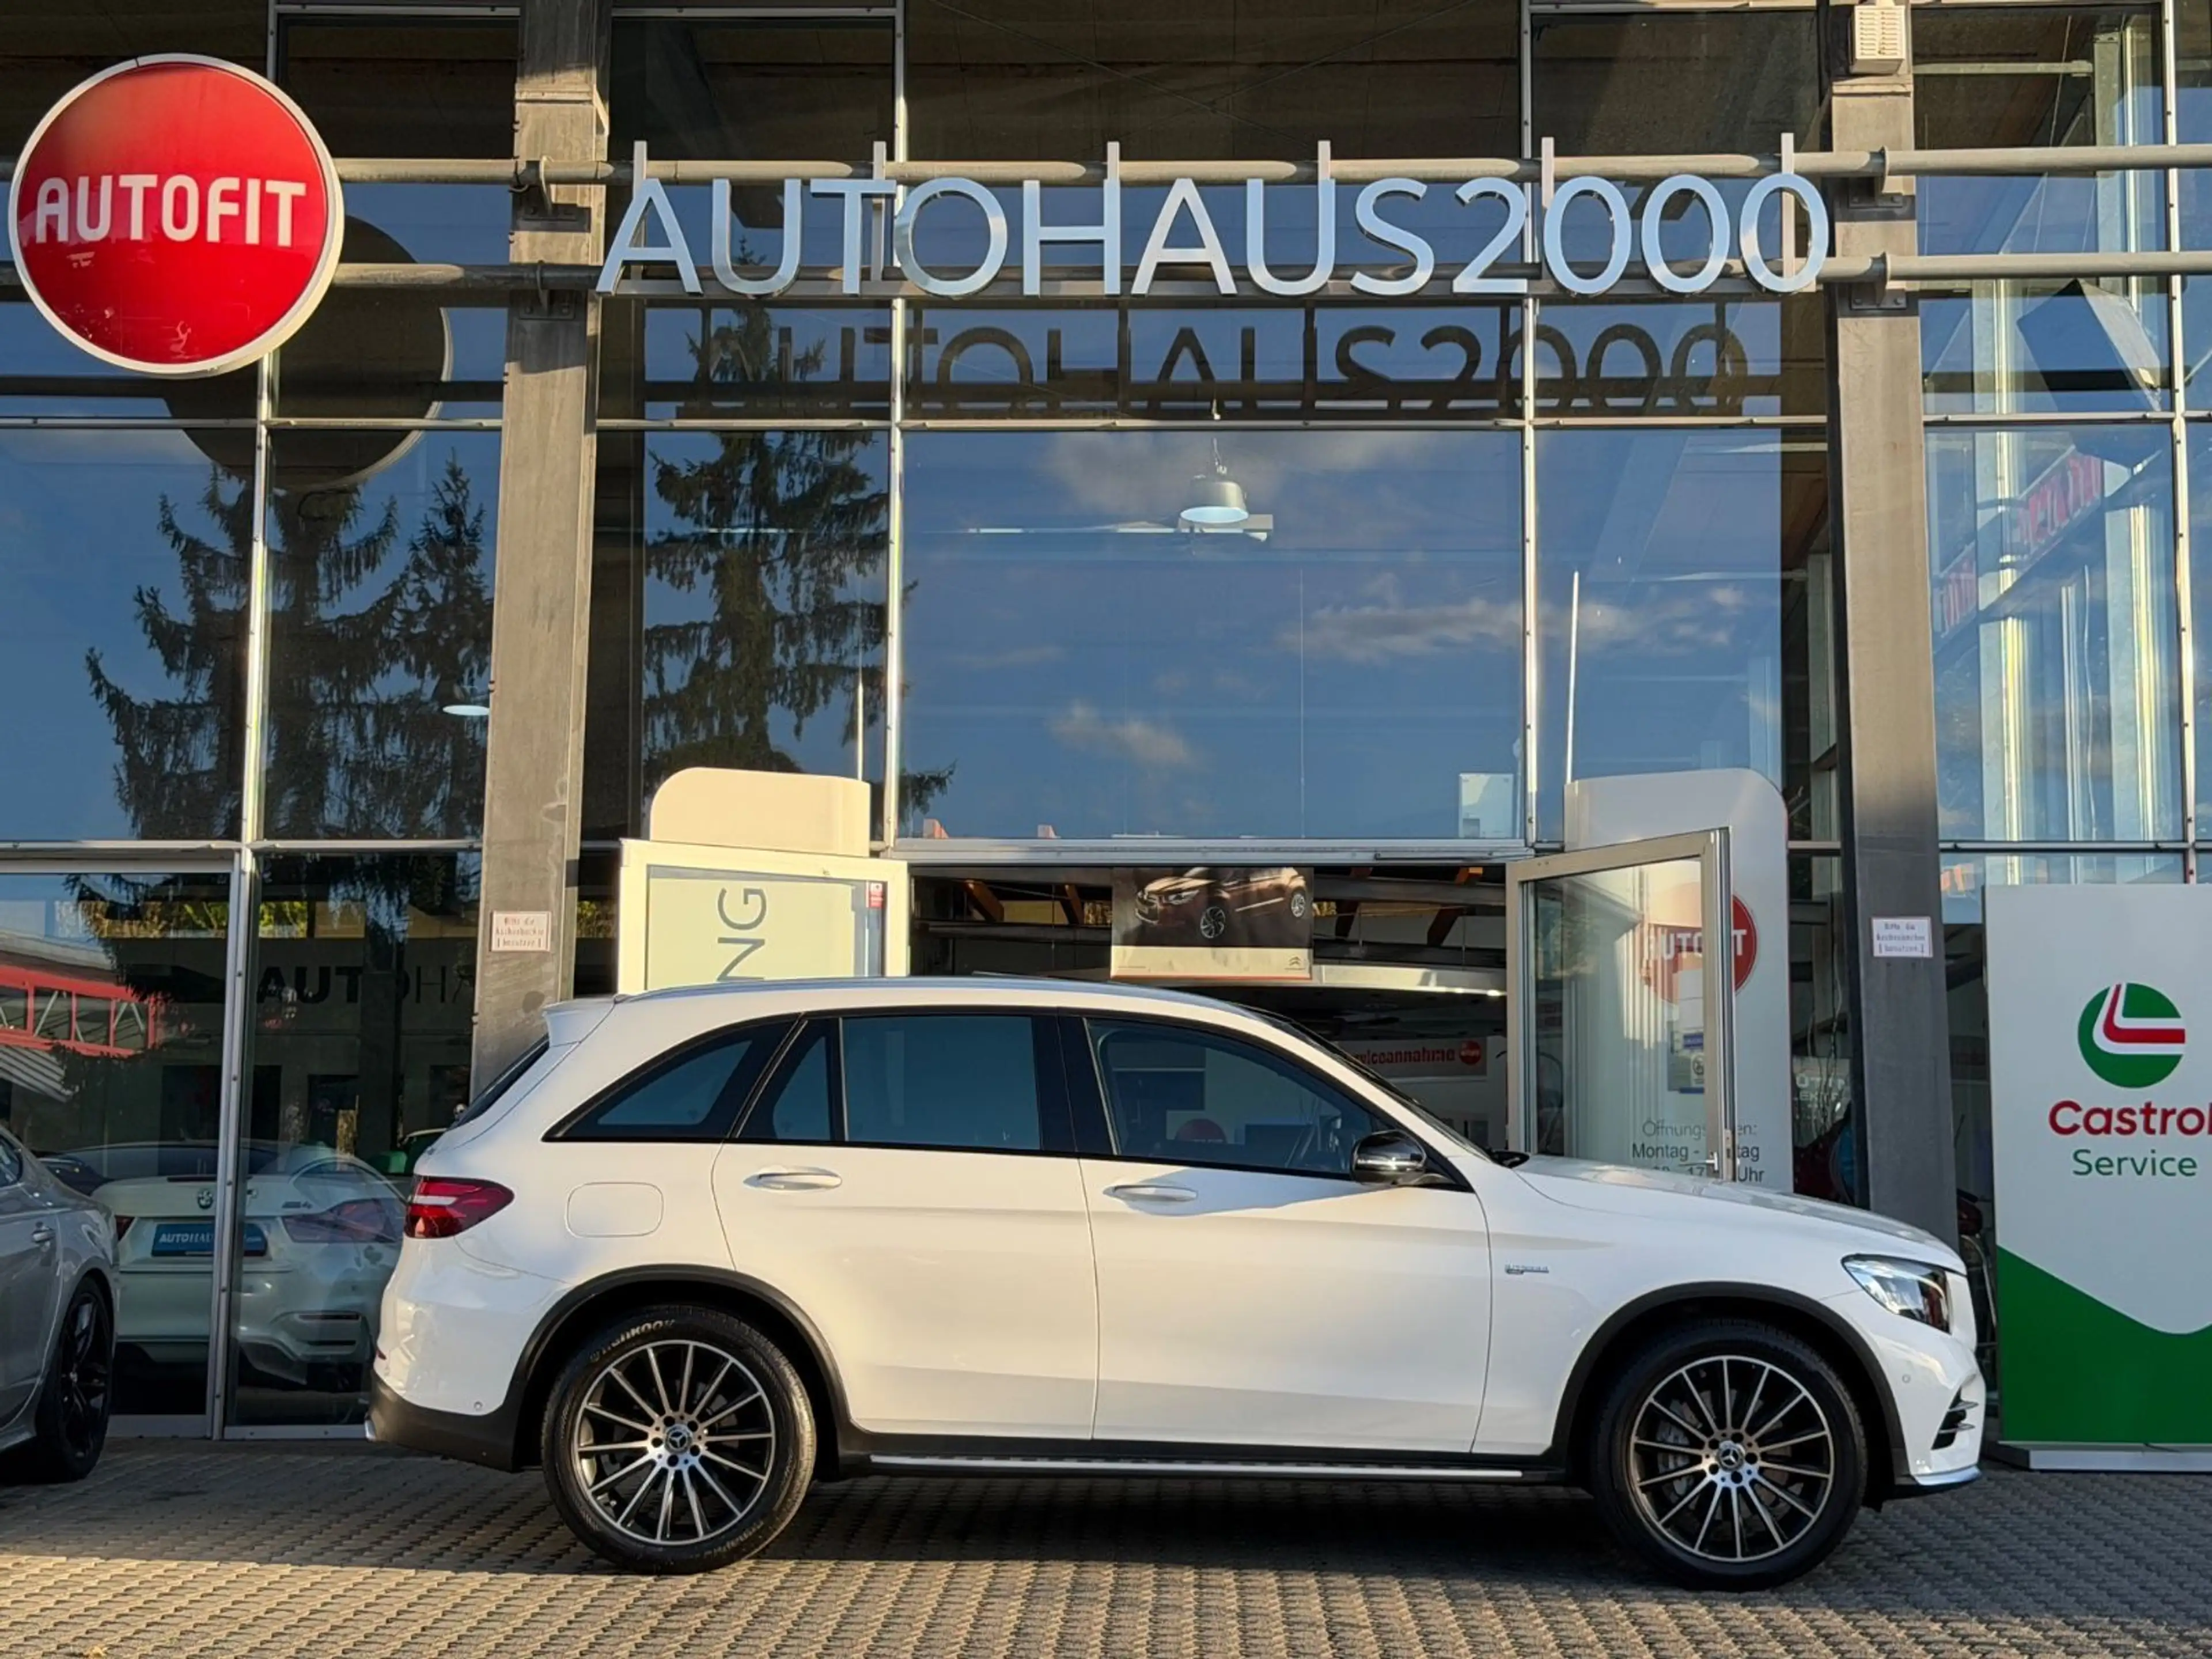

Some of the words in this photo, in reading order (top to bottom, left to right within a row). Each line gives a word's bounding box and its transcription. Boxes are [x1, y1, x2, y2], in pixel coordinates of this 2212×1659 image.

[36, 175, 306, 247] AUTOFIT
[596, 174, 1829, 296] AUTOHAUS2000
[2048, 1100, 2212, 1136] Castrol
[1633, 1143, 1689, 1161] Montag
[2072, 1149, 2198, 1177] Service
[1737, 1166, 1765, 1182] Uhr
